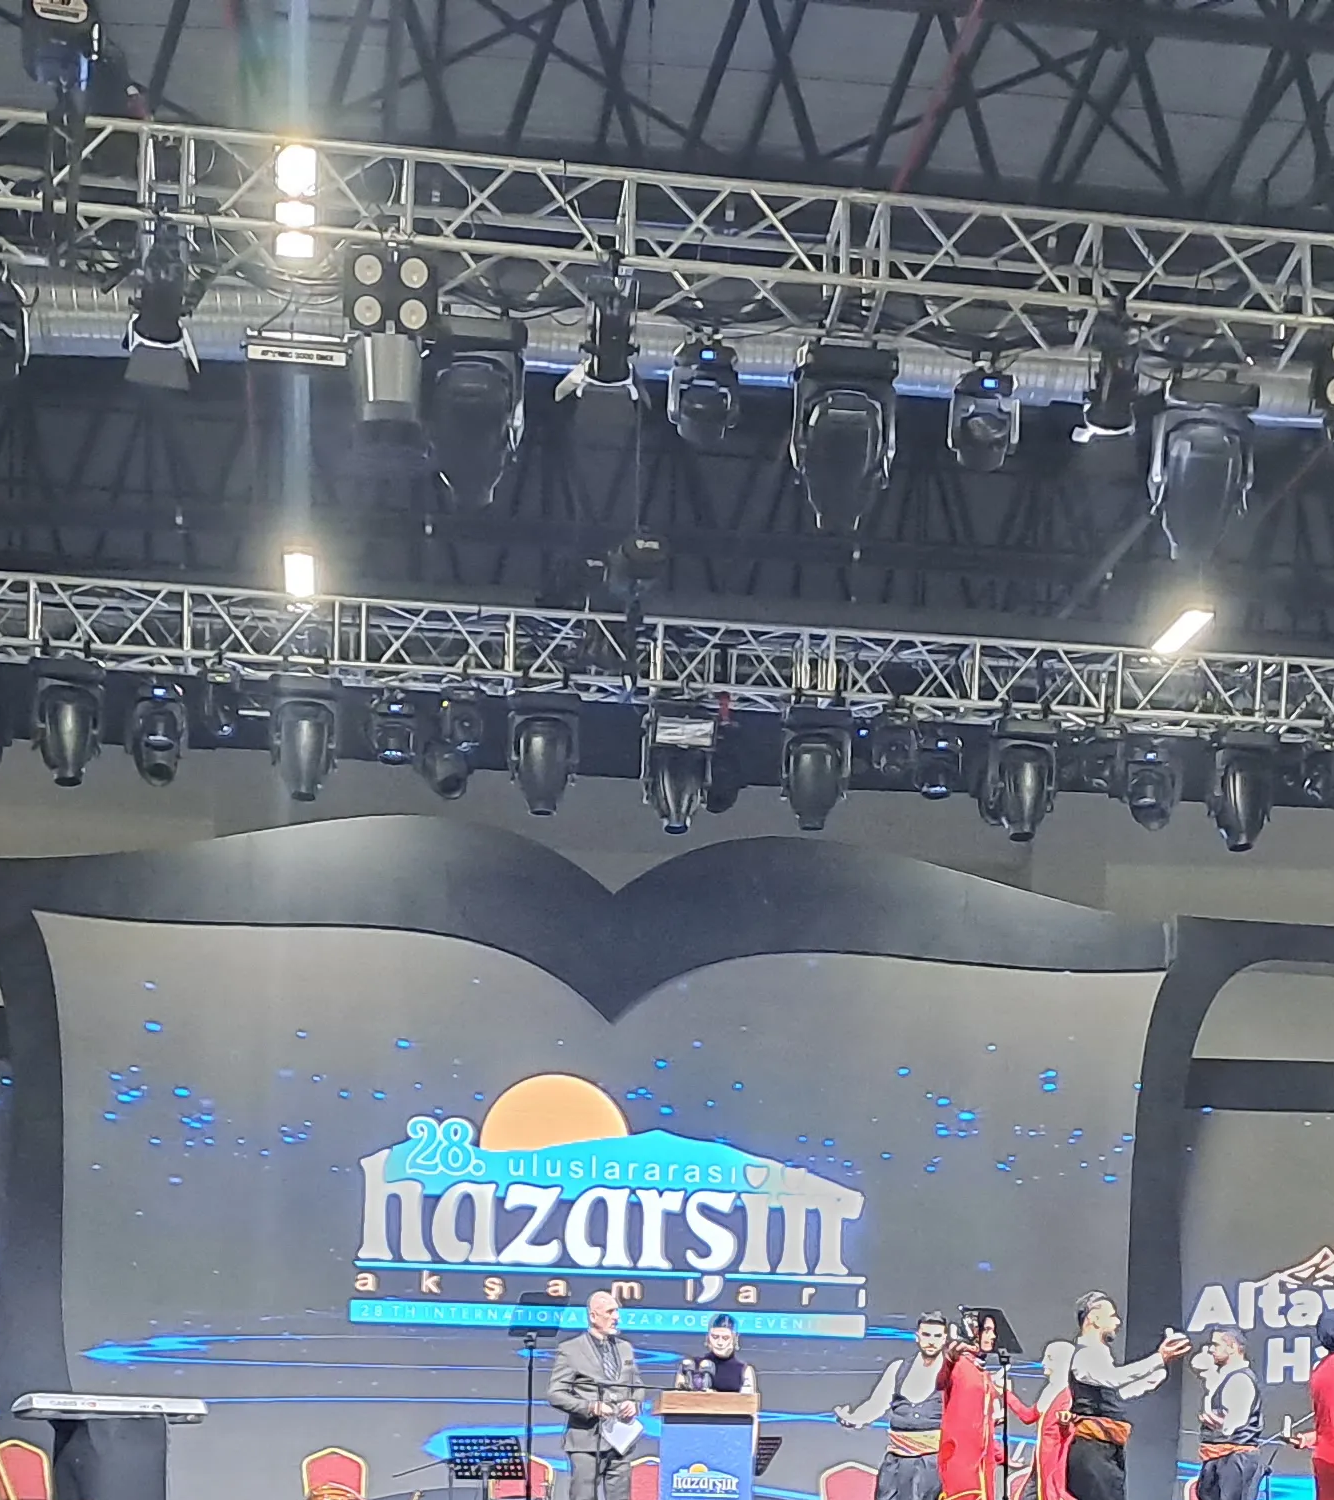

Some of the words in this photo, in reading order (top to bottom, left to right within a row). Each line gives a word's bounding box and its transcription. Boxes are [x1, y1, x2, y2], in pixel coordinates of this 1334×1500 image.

[405, 1115, 486, 1176] 28.
[507, 1153, 737, 1185] uluslararası
[357, 1149, 865, 1303] hazarşiir
[671, 1315, 747, 1328] POEY
